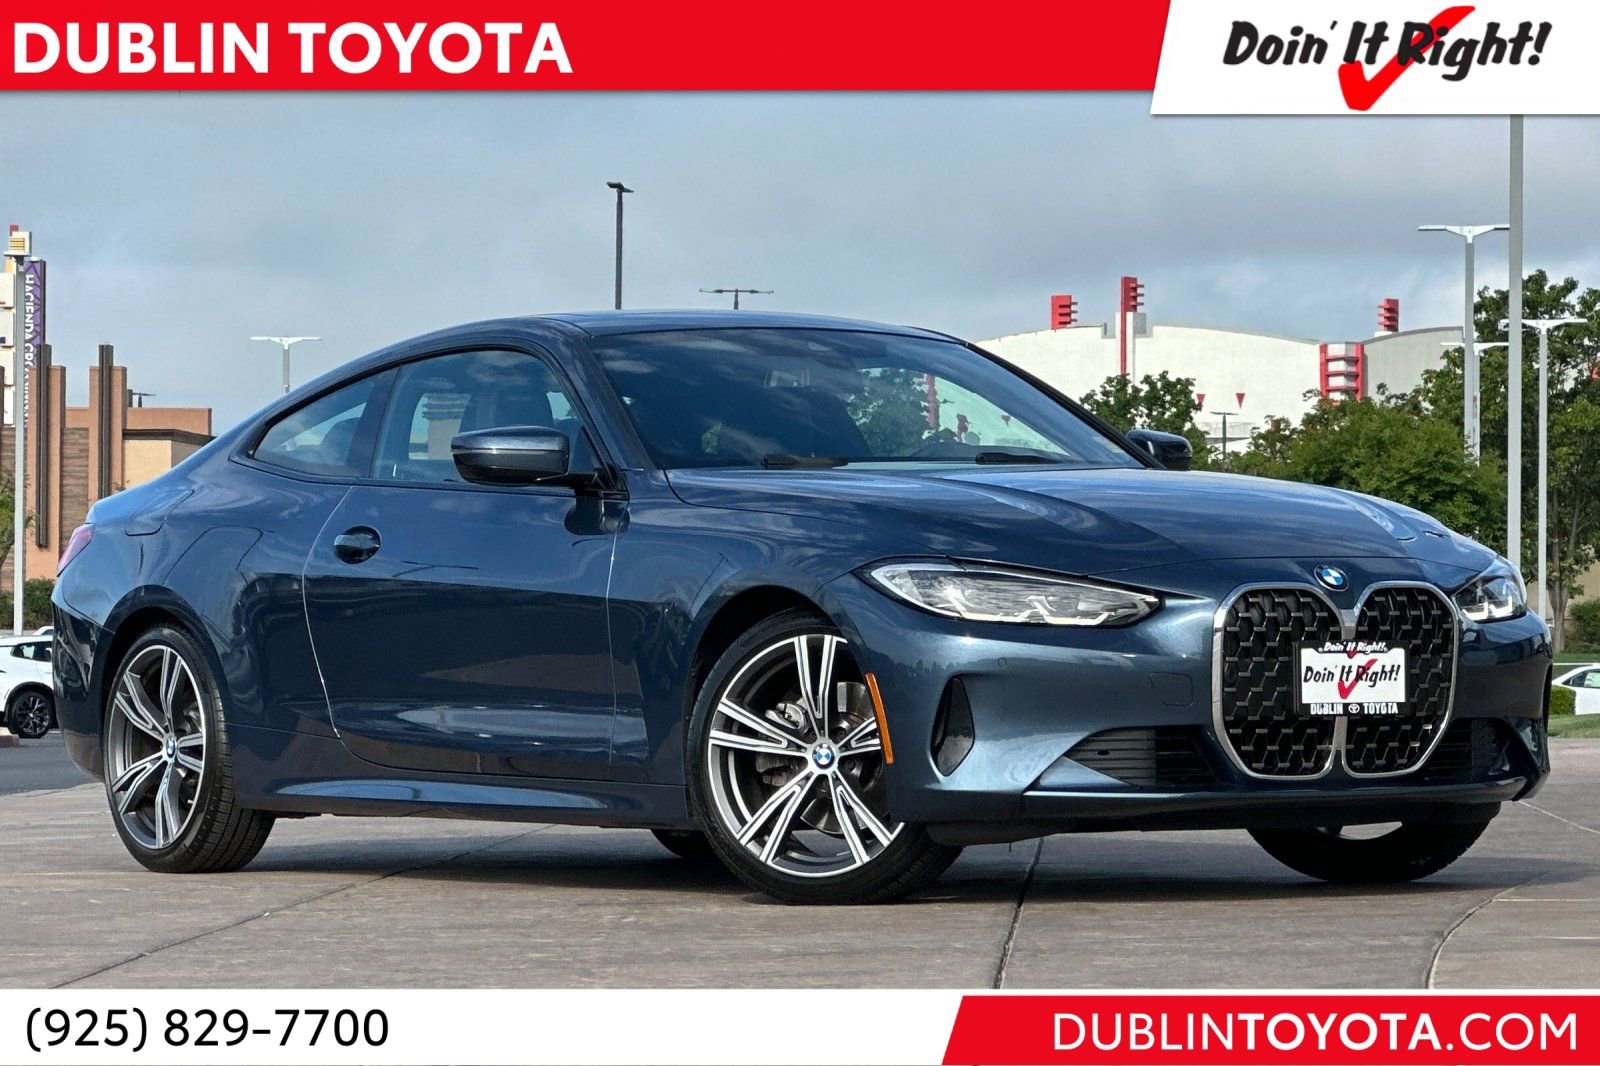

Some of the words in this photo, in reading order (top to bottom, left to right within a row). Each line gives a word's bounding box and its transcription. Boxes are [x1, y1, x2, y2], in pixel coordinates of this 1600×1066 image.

[1346, 641, 1355, 652] It
[1356, 641, 1386, 655] Right!
[1303, 665, 1338, 683] Doin'
[1339, 665, 1352, 682] It
[1355, 664, 1401, 688] Right!
[1310, 703, 1344, 715] DUBLIN
[1363, 703, 1398, 715] TOYOTA
